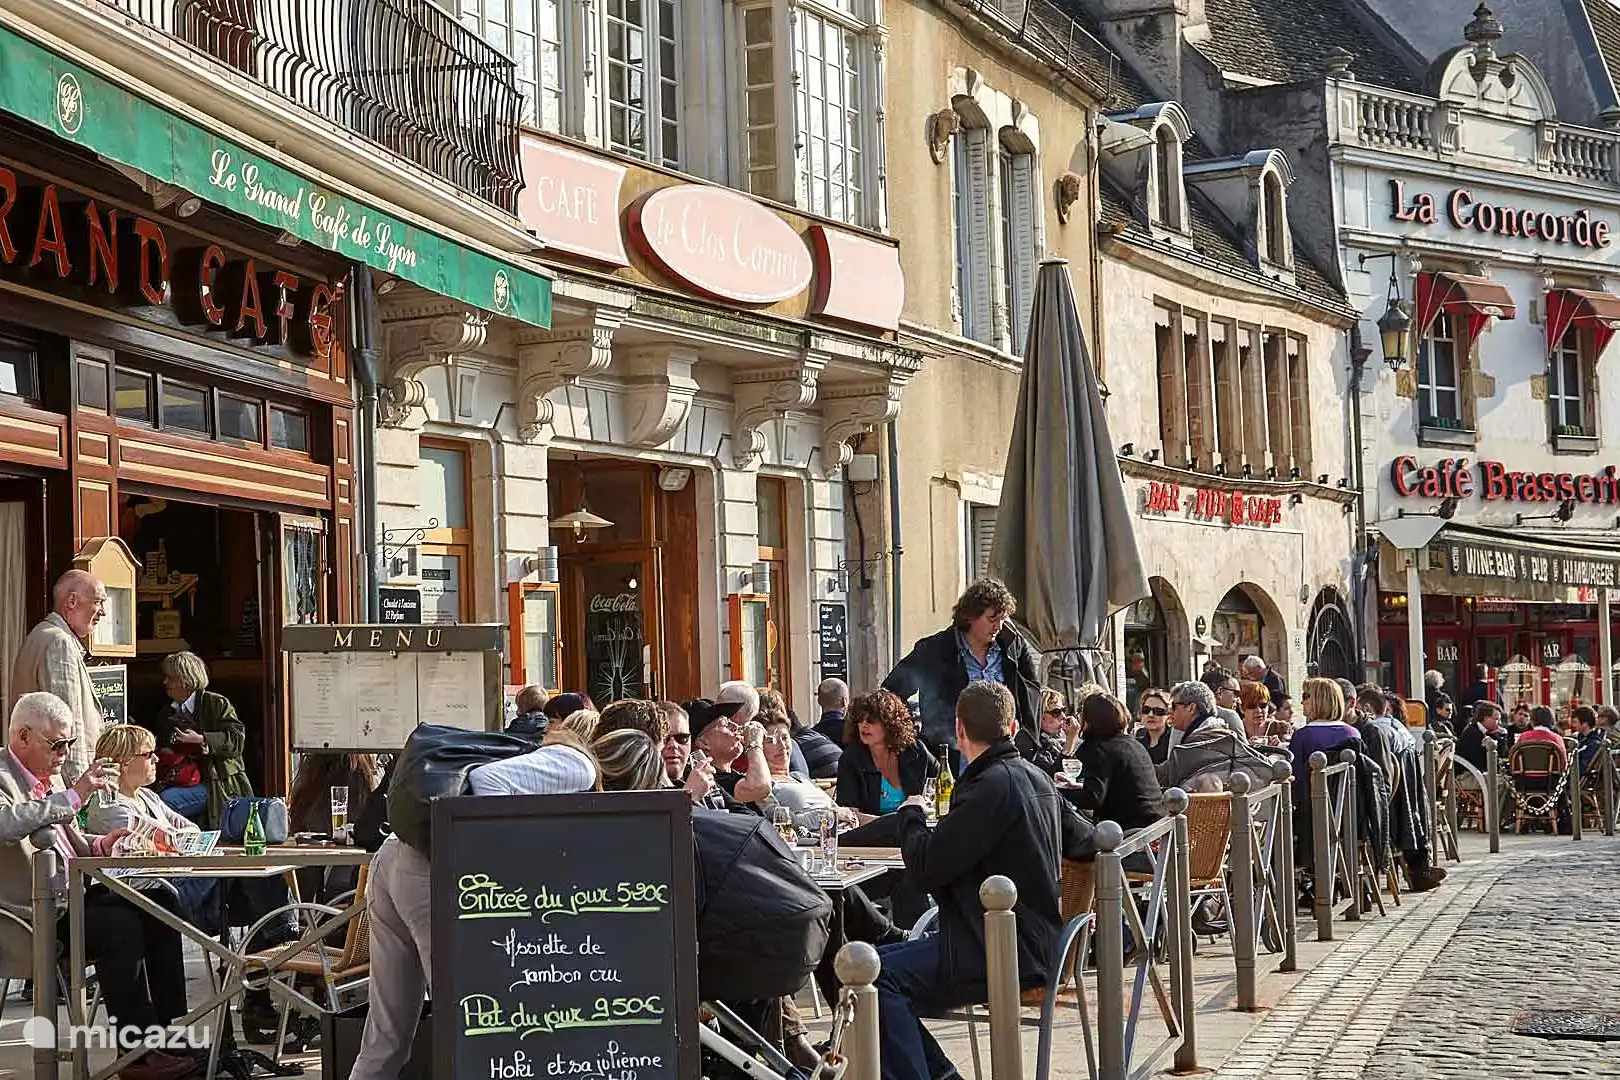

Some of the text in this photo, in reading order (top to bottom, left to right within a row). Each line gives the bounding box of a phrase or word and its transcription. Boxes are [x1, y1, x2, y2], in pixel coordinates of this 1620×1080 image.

[209, 149, 417, 273] Le Grand Café de Lyon
[1389, 179, 1611, 248] La Concorde
[1391, 456, 1474, 498] Café
[1148, 481, 1180, 512] BAR
[1195, 488, 1227, 518] PUB
[1465, 547, 1496, 576] WINE
[1495, 551, 1517, 578] BAR
[1530, 556, 1549, 582] PUB
[1563, 559, 1615, 586] HAMBURGERS
[334, 629, 443, 648] MENU
[1437, 646, 1458, 662] BAR
[458, 873, 532, 910] Entrée
[534, 885, 564, 909] du
[541, 885, 612, 925] jour
[491, 927, 606, 968] Assiette de
[509, 963, 623, 993] jambon cru
[459, 993, 505, 1028] Plat
[510, 1001, 541, 1028] du
[519, 1003, 586, 1041] jour
[490, 1050, 535, 1079] Hoki
[547, 1053, 568, 1076] et
[568, 1059, 593, 1074] sa
[580, 1039, 663, 1077] julienne
